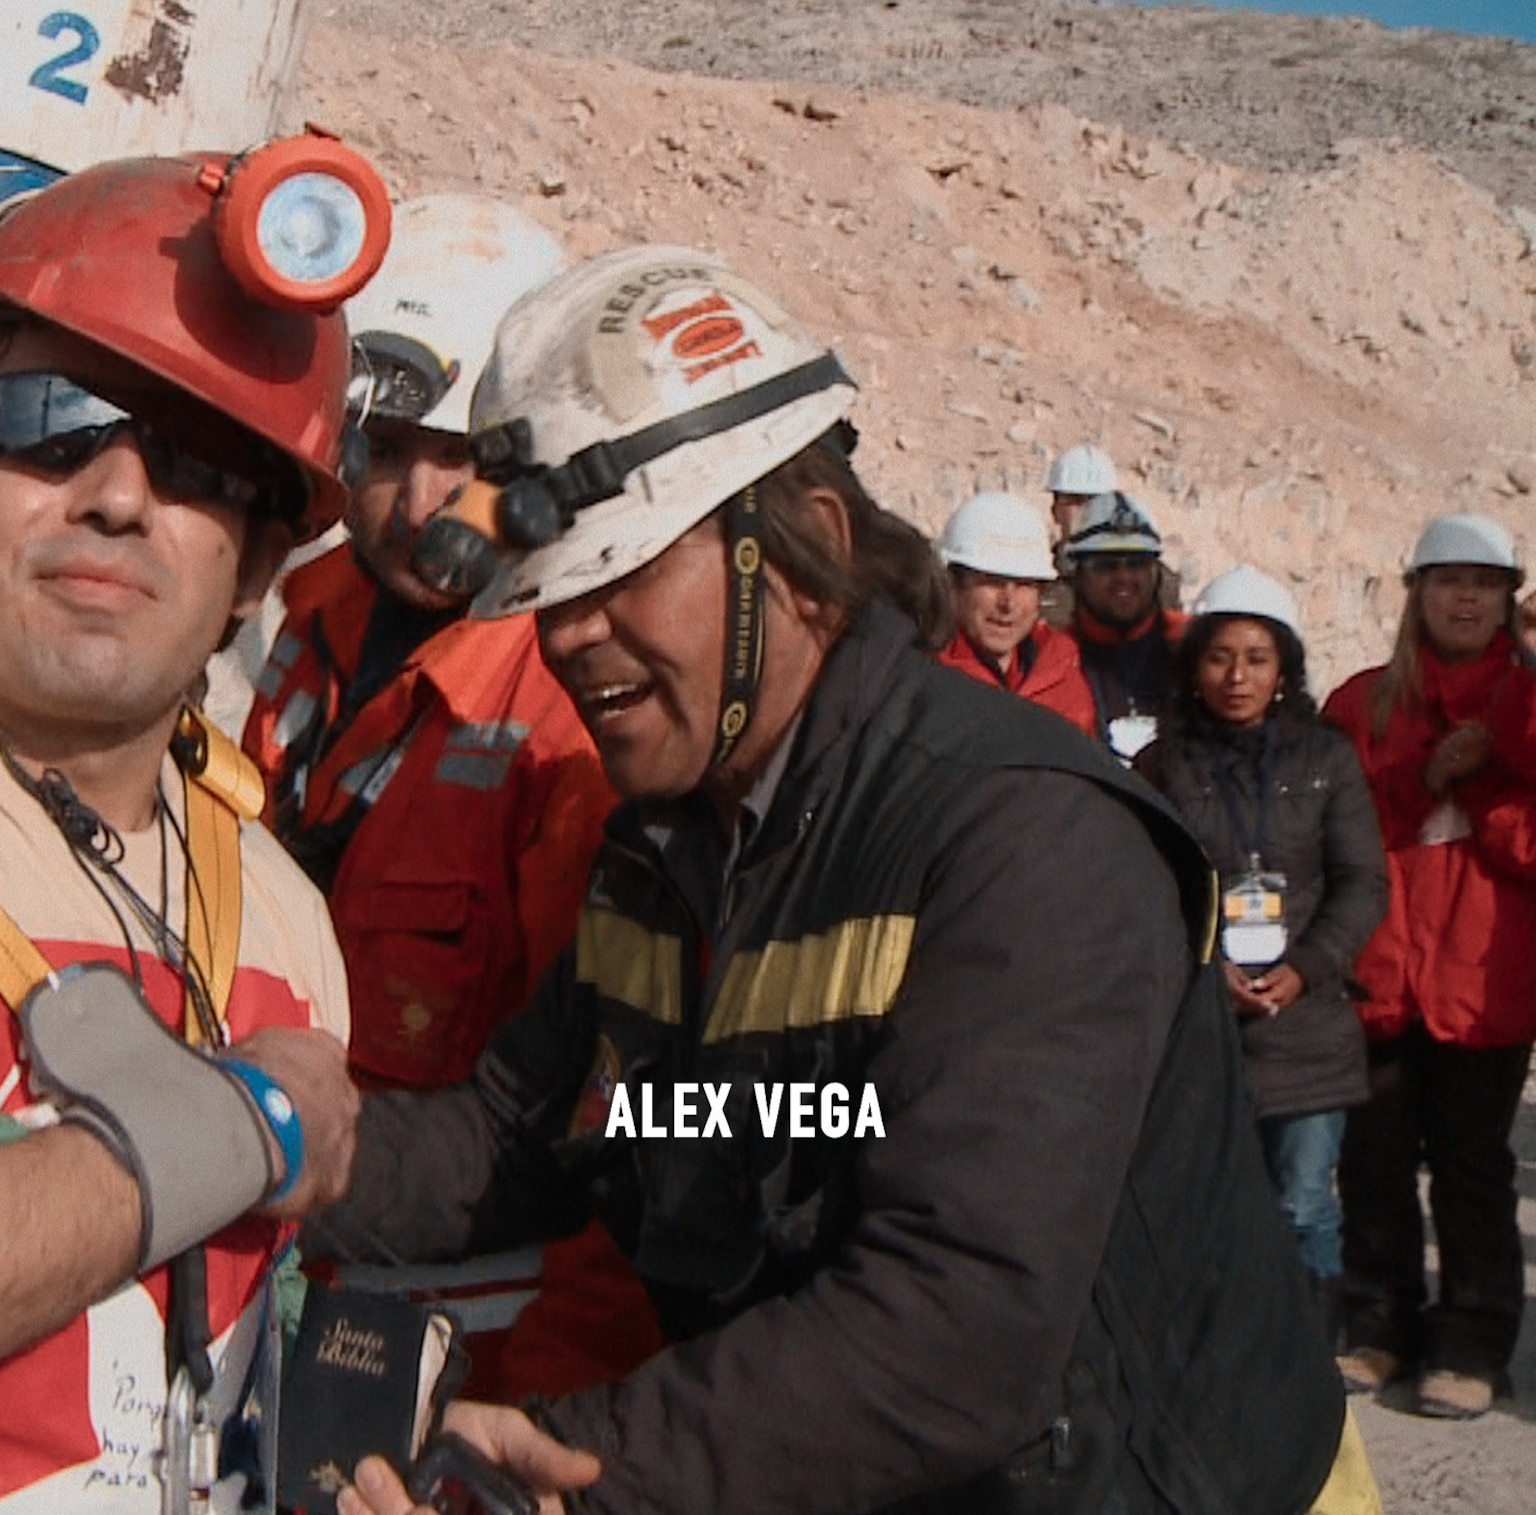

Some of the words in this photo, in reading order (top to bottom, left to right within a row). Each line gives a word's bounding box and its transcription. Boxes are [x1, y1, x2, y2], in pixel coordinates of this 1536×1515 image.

[28, 11, 101, 105] 2
[324, 1316, 384, 1352] Santa
[316, 1339, 385, 1377] Biblia
